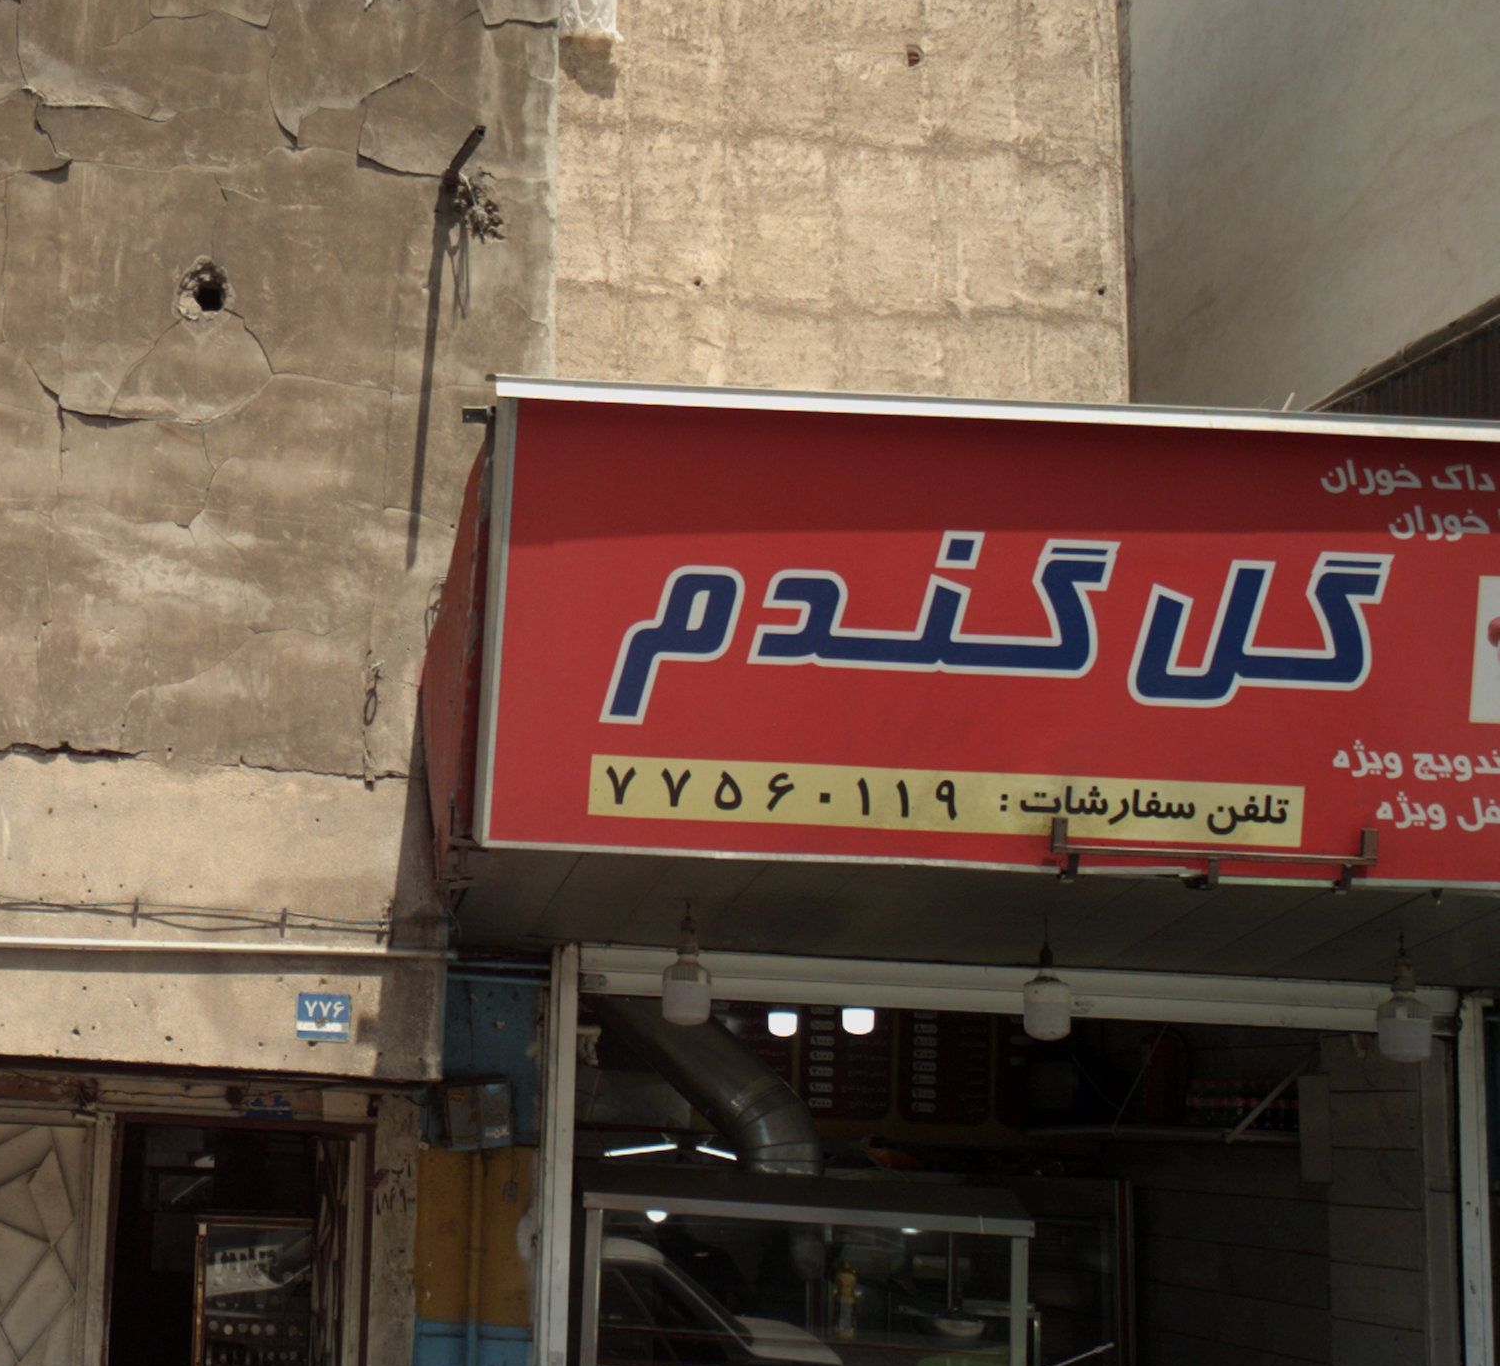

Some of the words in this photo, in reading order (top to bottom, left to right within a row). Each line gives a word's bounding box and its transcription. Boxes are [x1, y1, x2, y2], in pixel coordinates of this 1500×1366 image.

[1320, 458, 1422, 496] خوران
[1388, 505, 1491, 542] خوران
[599, 530, 1120, 725] گندم
[1128, 550, 1394, 708] گل
[1332, 739, 1404, 779] ویژه
[606, 765, 958, 822] ۷۷۵۶۰۱۱۹
[1376, 791, 1447, 830] ویژه
[1207, 795, 1290, 835] تلفن
[303, 999, 345, 1019] ۷۷۶
